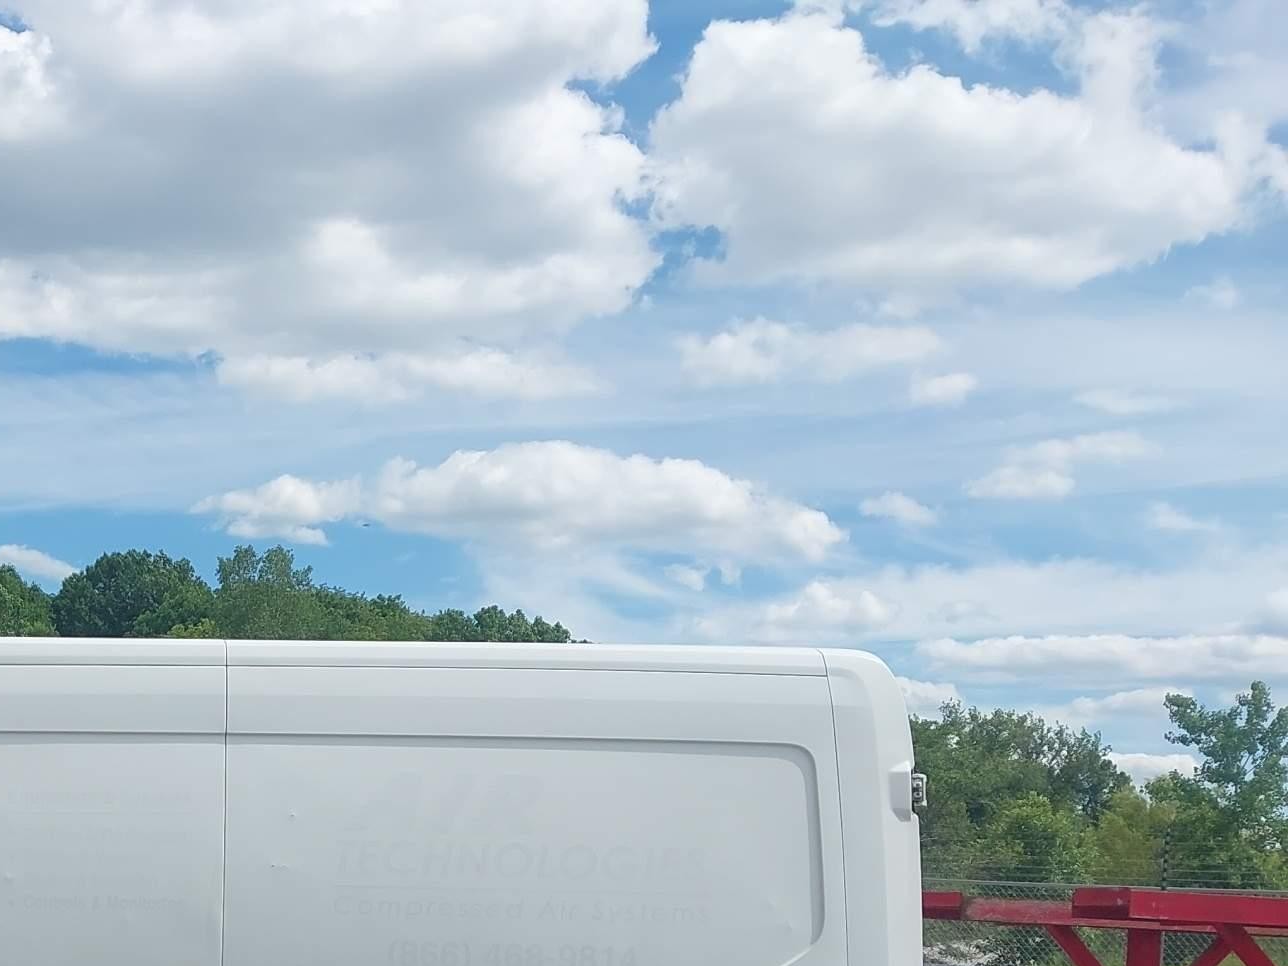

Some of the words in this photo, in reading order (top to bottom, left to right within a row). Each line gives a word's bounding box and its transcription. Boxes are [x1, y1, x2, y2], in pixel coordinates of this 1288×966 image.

[335, 839, 709, 882] TECHNOLOGIES
[330, 895, 525, 921] Compressed
[536, 895, 578, 921] Air
[590, 897, 711, 926] Systems
